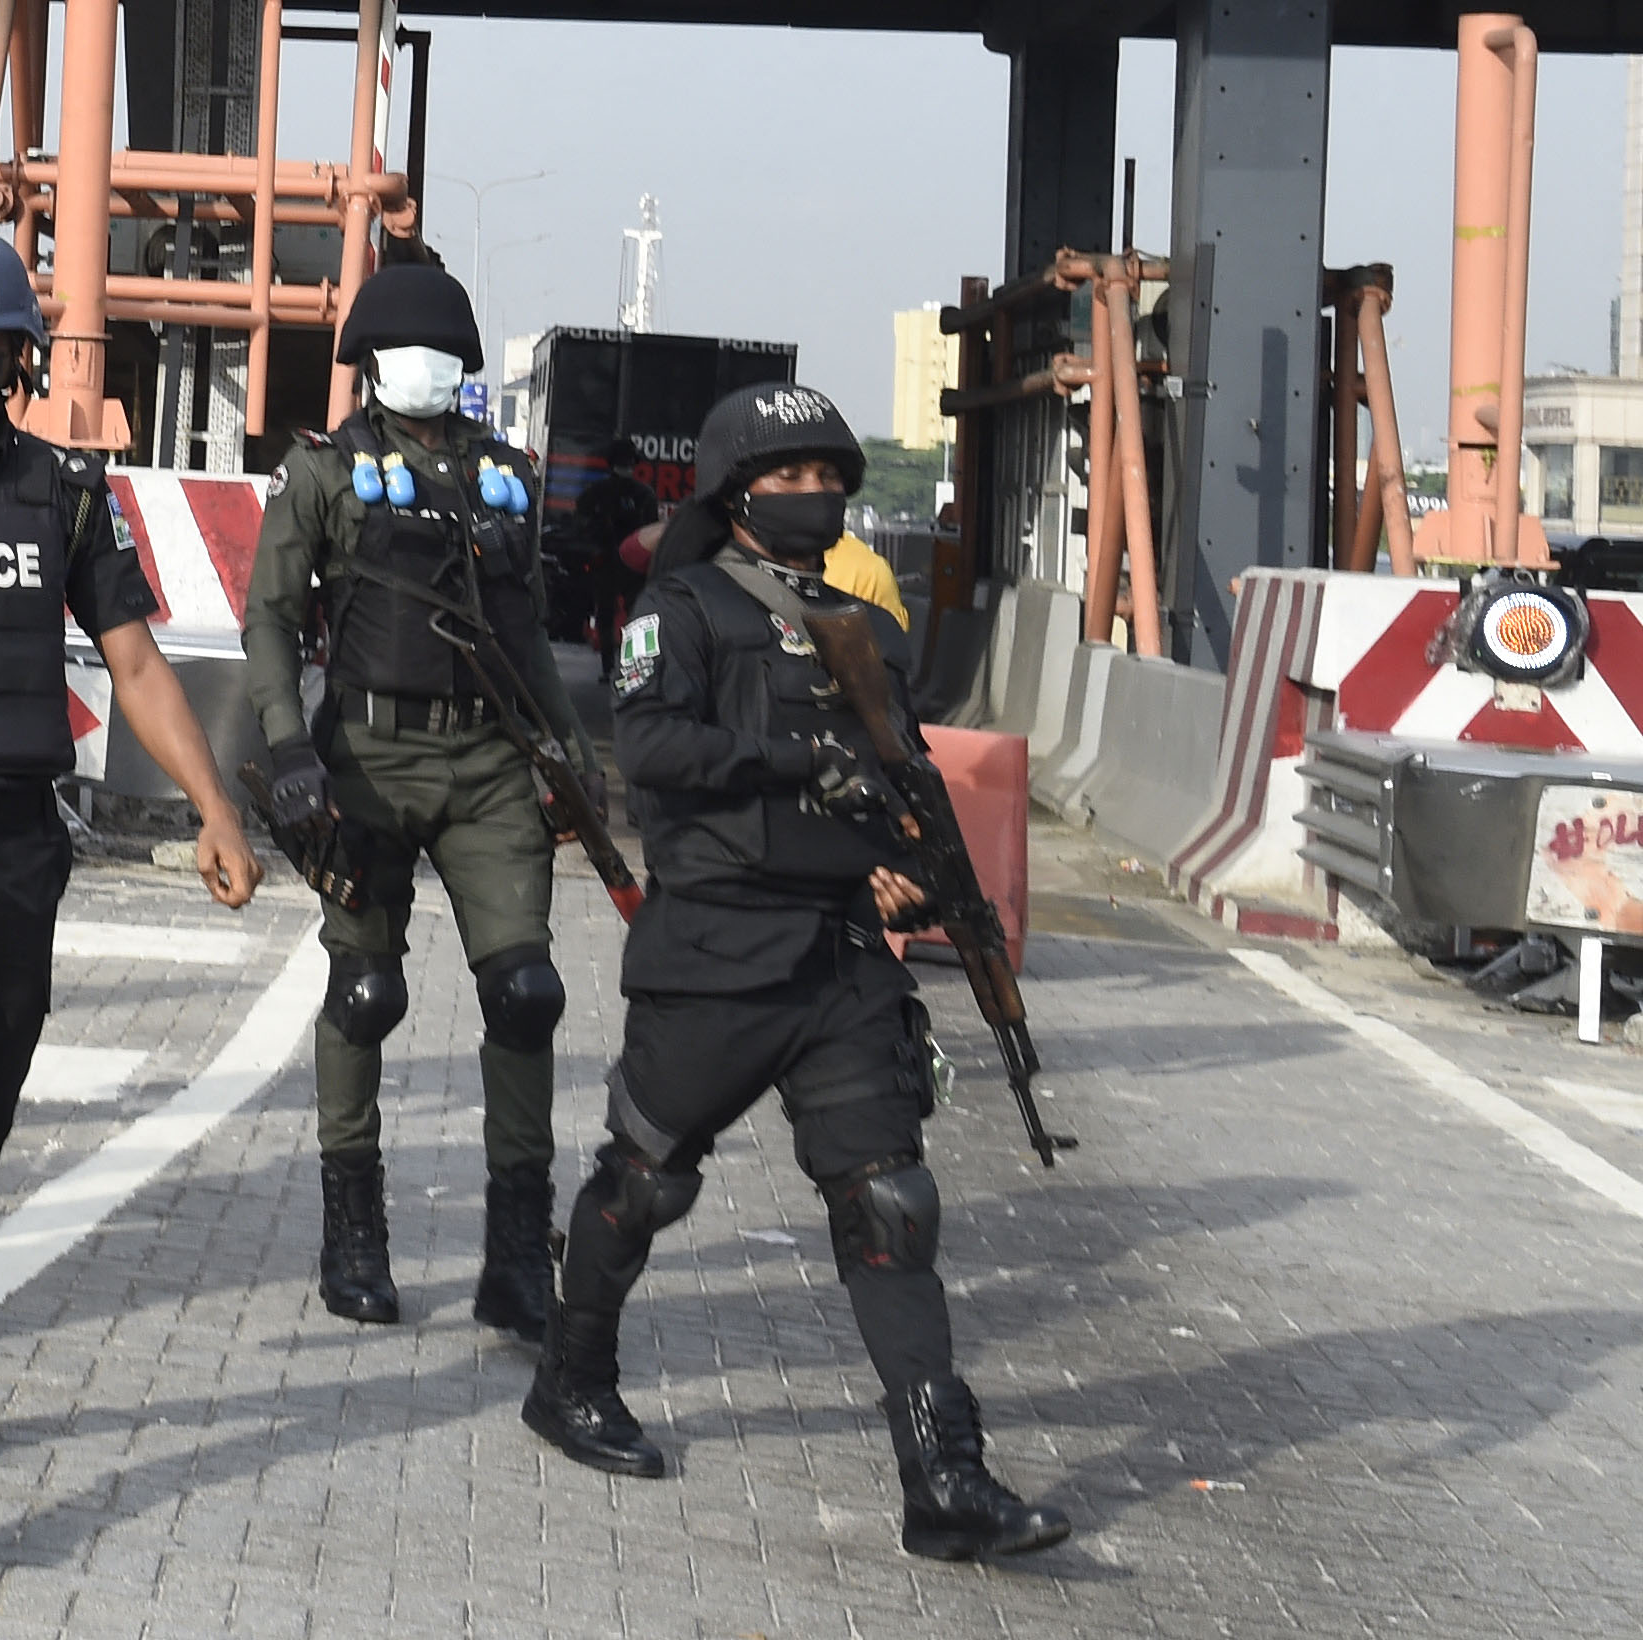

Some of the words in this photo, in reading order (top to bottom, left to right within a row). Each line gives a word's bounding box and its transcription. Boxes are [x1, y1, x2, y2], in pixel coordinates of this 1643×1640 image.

[556, 326, 633, 343] POLICE
[717, 337, 796, 356] POLICE
[630, 434, 699, 464] POLIC
